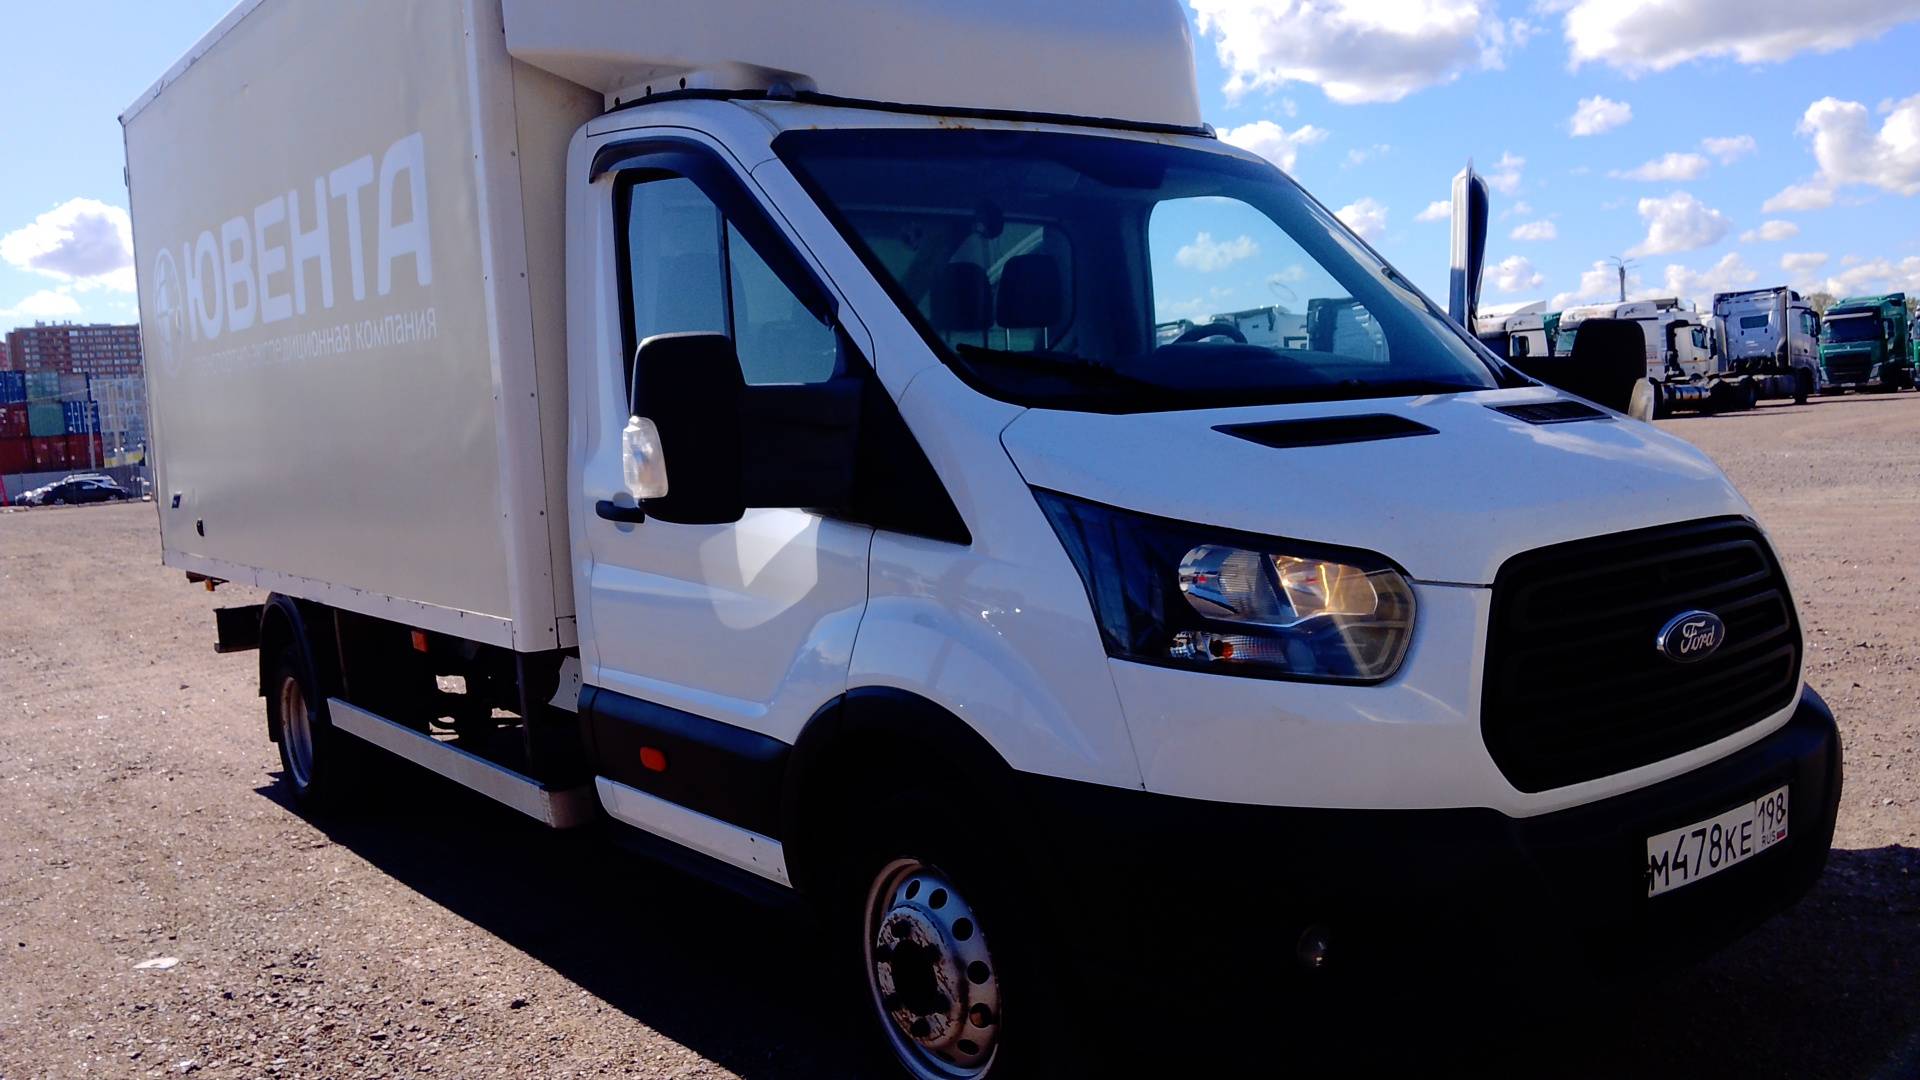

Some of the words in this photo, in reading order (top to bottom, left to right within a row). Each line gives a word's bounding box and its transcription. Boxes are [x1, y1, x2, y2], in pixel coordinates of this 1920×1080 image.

[183, 131, 432, 341] ЮВЕНТА
[1680, 620, 1715, 653] Ford
[1650, 820, 1753, 891] М478КЕ
[1758, 792, 1786, 833] 198
[1761, 830, 1776, 847] RUS
